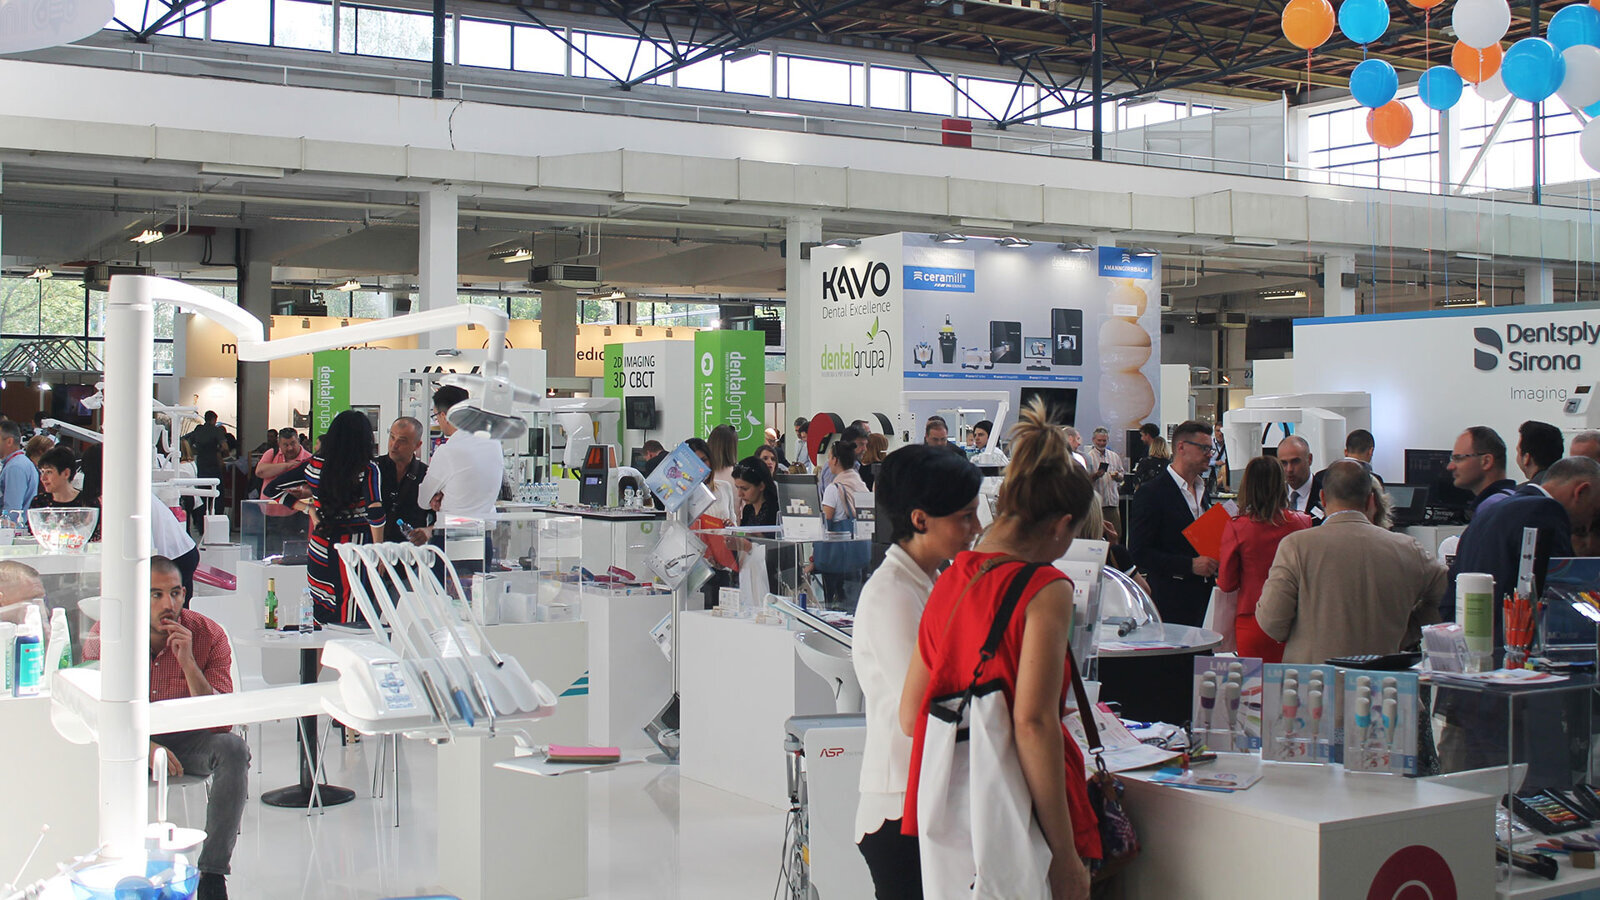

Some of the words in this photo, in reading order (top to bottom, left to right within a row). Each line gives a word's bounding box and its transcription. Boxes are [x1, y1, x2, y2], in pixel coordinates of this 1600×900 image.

[823, 261, 891, 302] KAVO
[822, 304, 847, 319] Dental
[850, 301, 891, 316] Excellence
[1507, 321, 1600, 346] Dentsply
[613, 357, 623, 368] 2D
[624, 355, 655, 368] IMAGING
[821, 343, 885, 377] dentalgrupa
[1508, 351, 1581, 371] Sirona
[613, 372, 627, 388] 3D
[629, 371, 655, 388] CBCT
[317, 366, 334, 428] dentalgrupa
[725, 351, 746, 432] dentalgrupa
[1510, 385, 1567, 402] Imaging
[704, 383, 713, 443] KULZ
[820, 747, 845, 758] ASP
